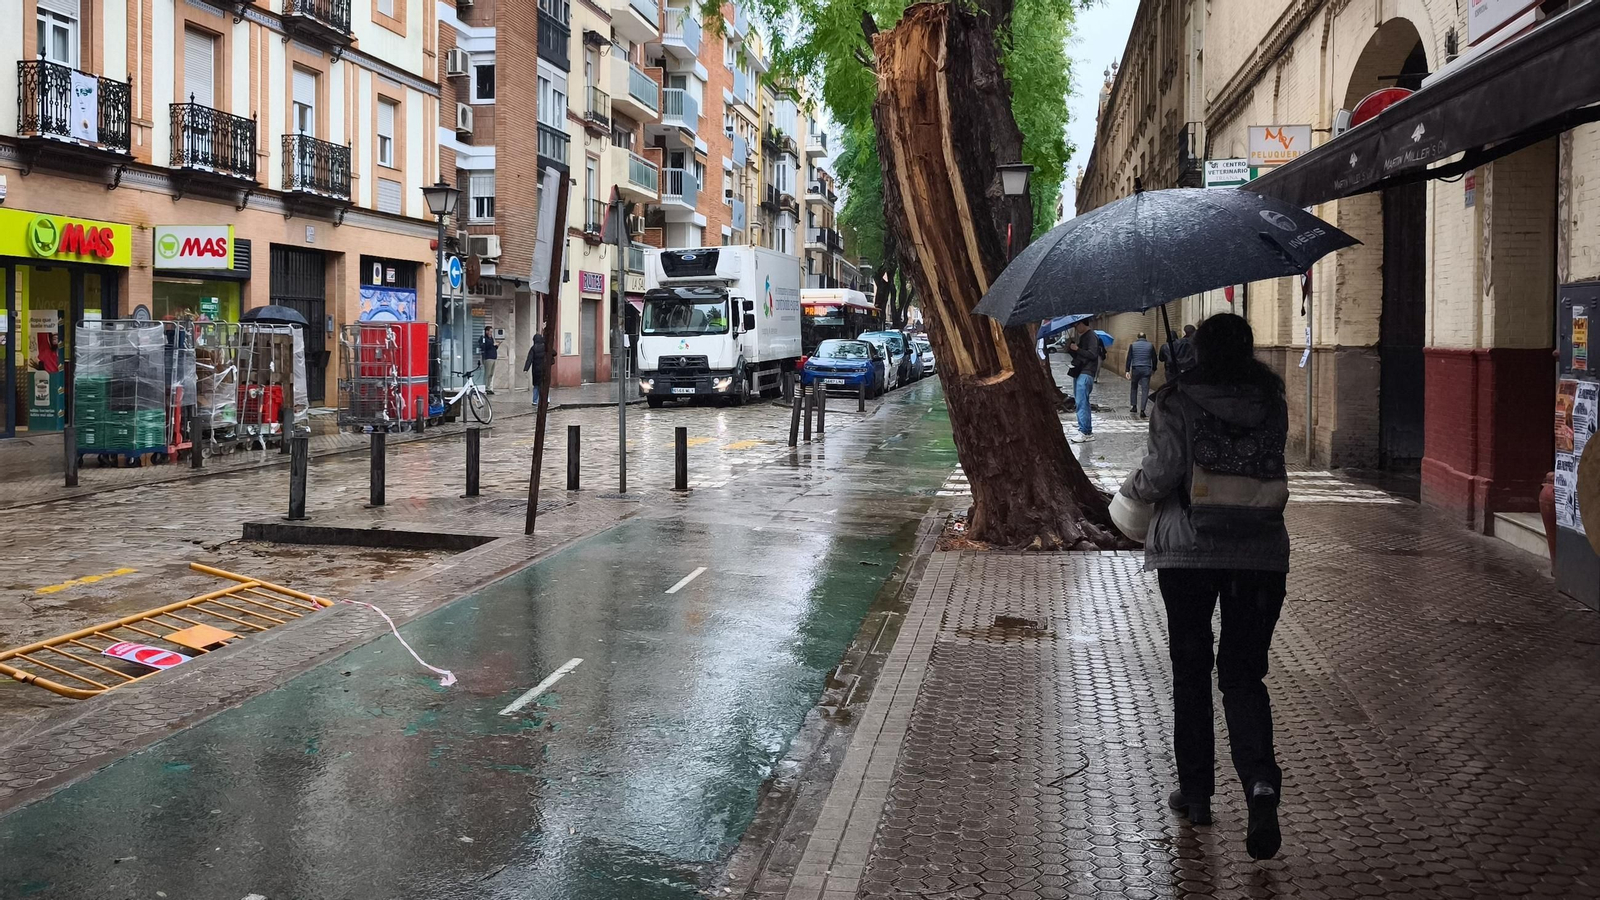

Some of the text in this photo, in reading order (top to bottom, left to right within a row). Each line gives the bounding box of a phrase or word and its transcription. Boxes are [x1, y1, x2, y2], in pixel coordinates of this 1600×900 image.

[1251, 151, 1306, 159] PELUQUERI
[1207, 168, 1249, 176] VETERINARIO
[59, 223, 115, 259] MAS
[179, 237, 227, 258] MAS
[1288, 227, 1326, 249] INESIS
